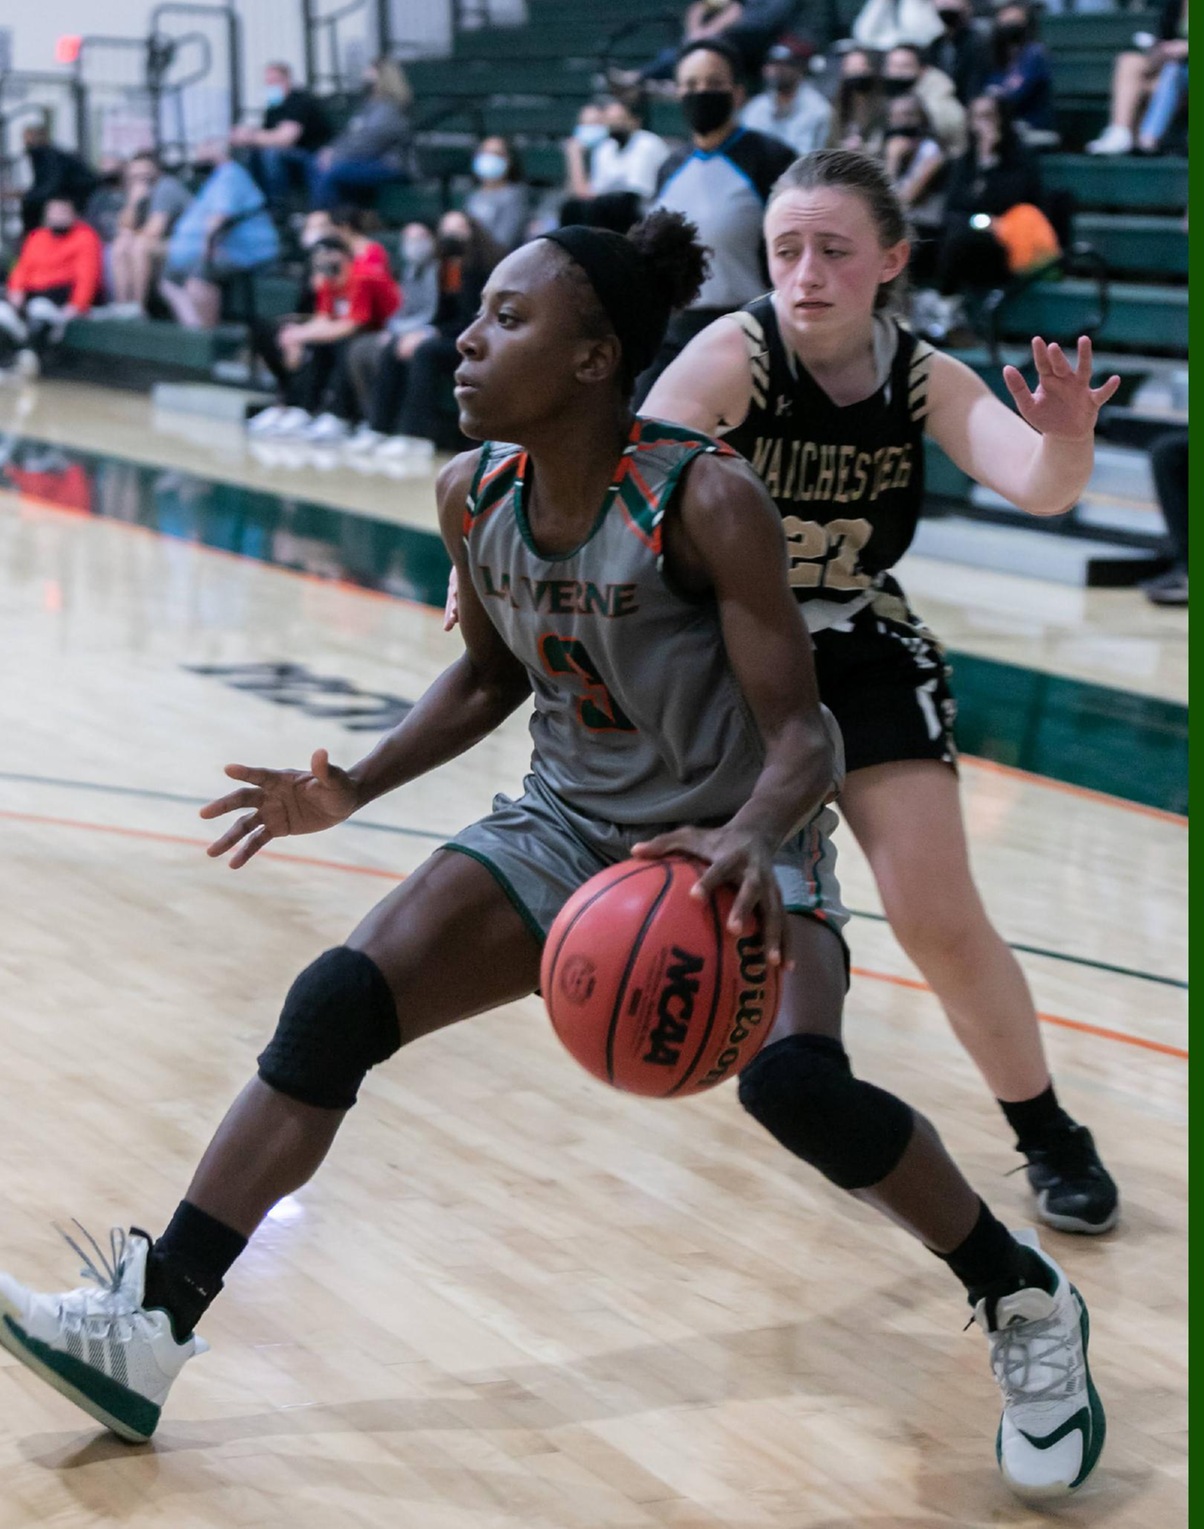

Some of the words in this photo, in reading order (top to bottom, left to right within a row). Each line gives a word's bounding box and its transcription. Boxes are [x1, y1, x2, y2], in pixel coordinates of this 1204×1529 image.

[781, 515, 873, 590] 22
[643, 945, 705, 1067] NCAA
[698, 934, 767, 1086] Wilson
